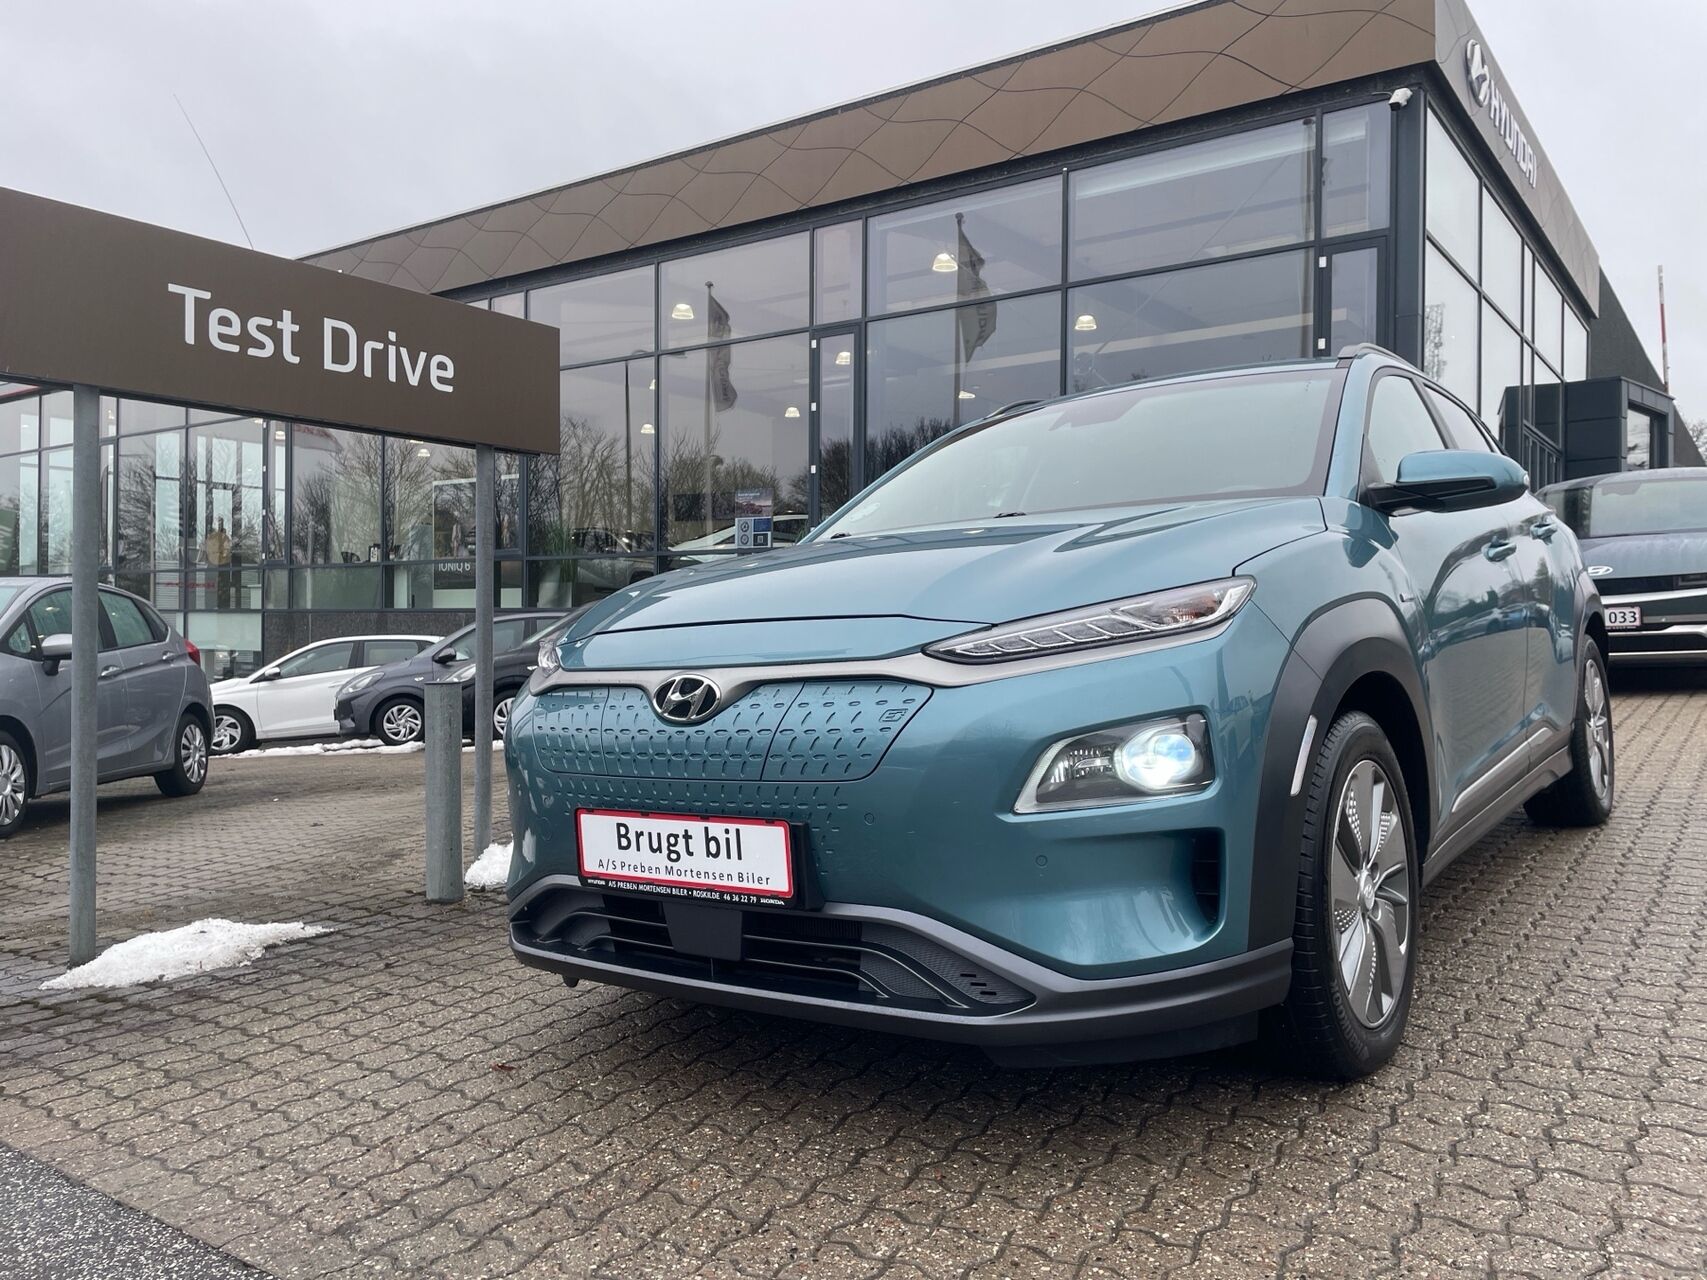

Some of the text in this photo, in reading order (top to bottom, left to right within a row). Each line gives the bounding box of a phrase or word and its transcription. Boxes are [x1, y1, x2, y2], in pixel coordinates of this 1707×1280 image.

[1489, 79, 1537, 189] HYUNDAI
[168, 283, 455, 393] Test Drive
[1608, 611, 1637, 624] 033
[615, 822, 743, 863] Brugt bil
[597, 858, 771, 886] A/S Preben Mortensen Biler
[617, 881, 637, 890] PREBEN
[638, 884, 671, 894] MORTENSEN
[672, 887, 688, 896] BILER
[692, 889, 720, 900] ROSKILDE
[723, 893, 731, 901] 46
[732, 894, 740, 902] 36
[740, 895, 748, 903] 22
[750, 896, 757, 904] 79
